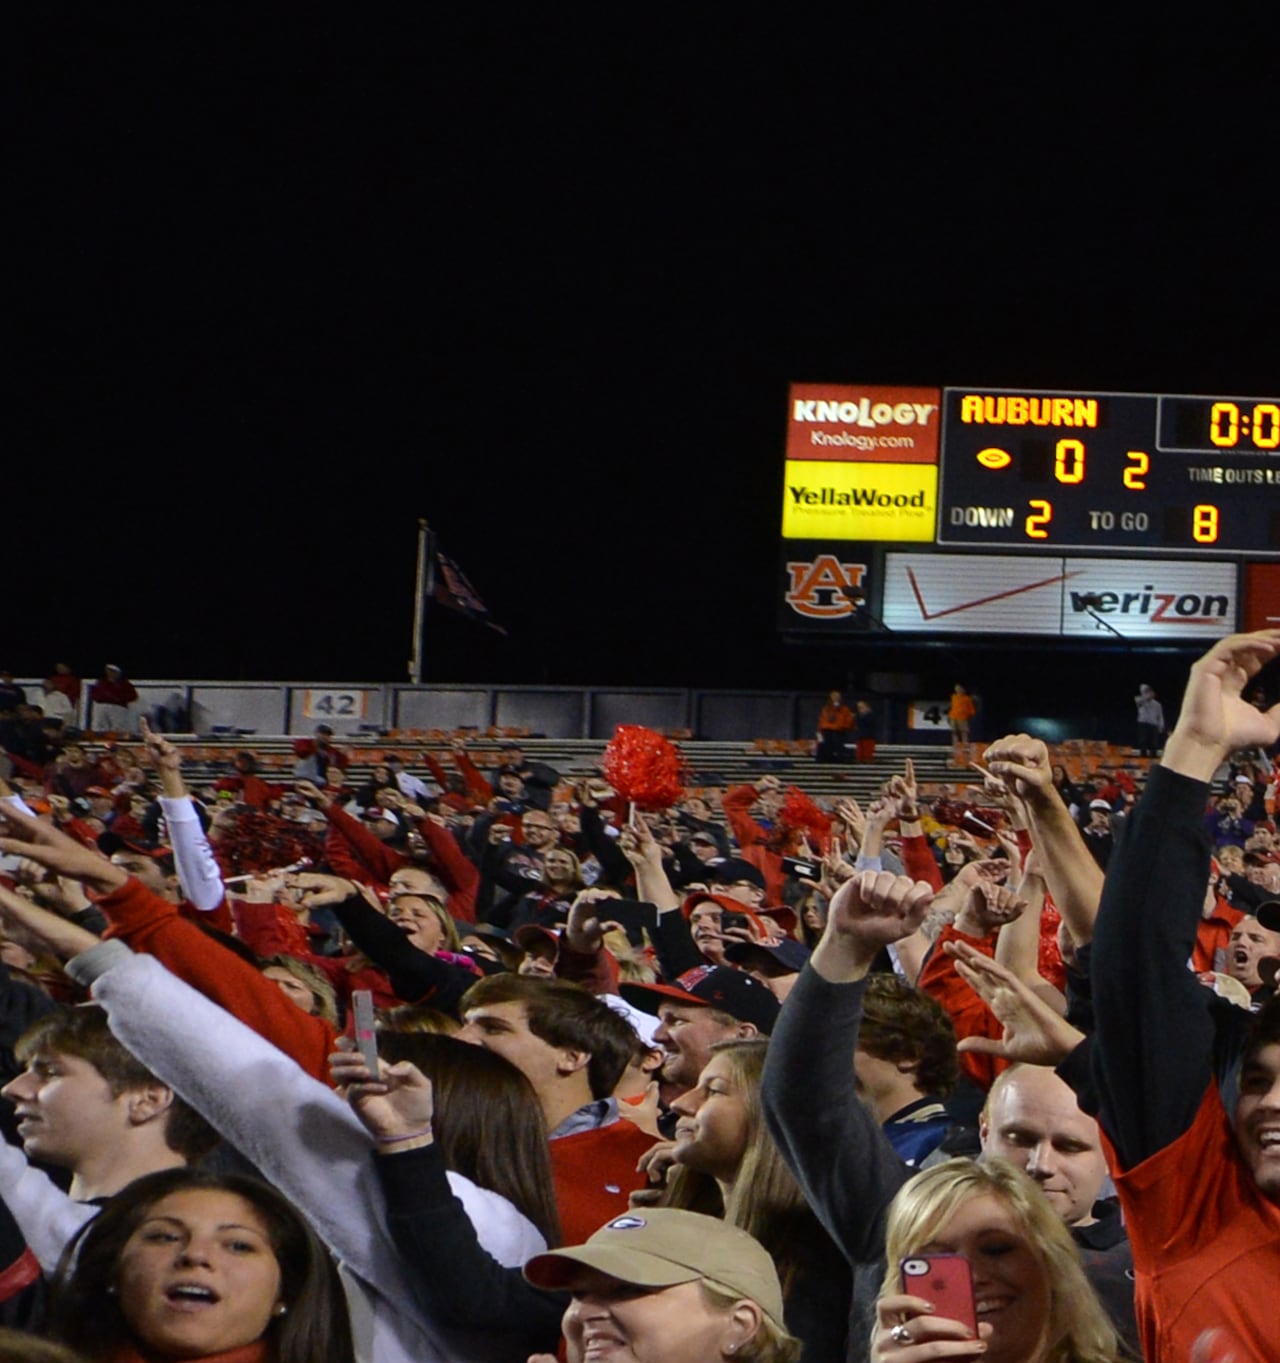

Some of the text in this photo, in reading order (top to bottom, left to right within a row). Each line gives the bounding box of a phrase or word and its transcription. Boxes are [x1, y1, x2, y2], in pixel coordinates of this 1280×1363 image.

[793, 398, 933, 428] KNOLOGY
[961, 395, 1098, 428] AUBURN
[811, 430, 915, 451] Knology.com
[1054, 438, 1085, 484] 0
[1123, 451, 1149, 490] 2
[1188, 466, 1224, 484] TIME
[1225, 467, 1264, 485] OUTS
[789, 486, 926, 508] YellaWood
[951, 506, 1014, 527] DOWN
[1025, 499, 1052, 538] 2
[1089, 510, 1148, 531] TO GO
[1192, 504, 1219, 543] 8
[1070, 585, 1229, 624] verizon
[316, 695, 355, 715] 42
